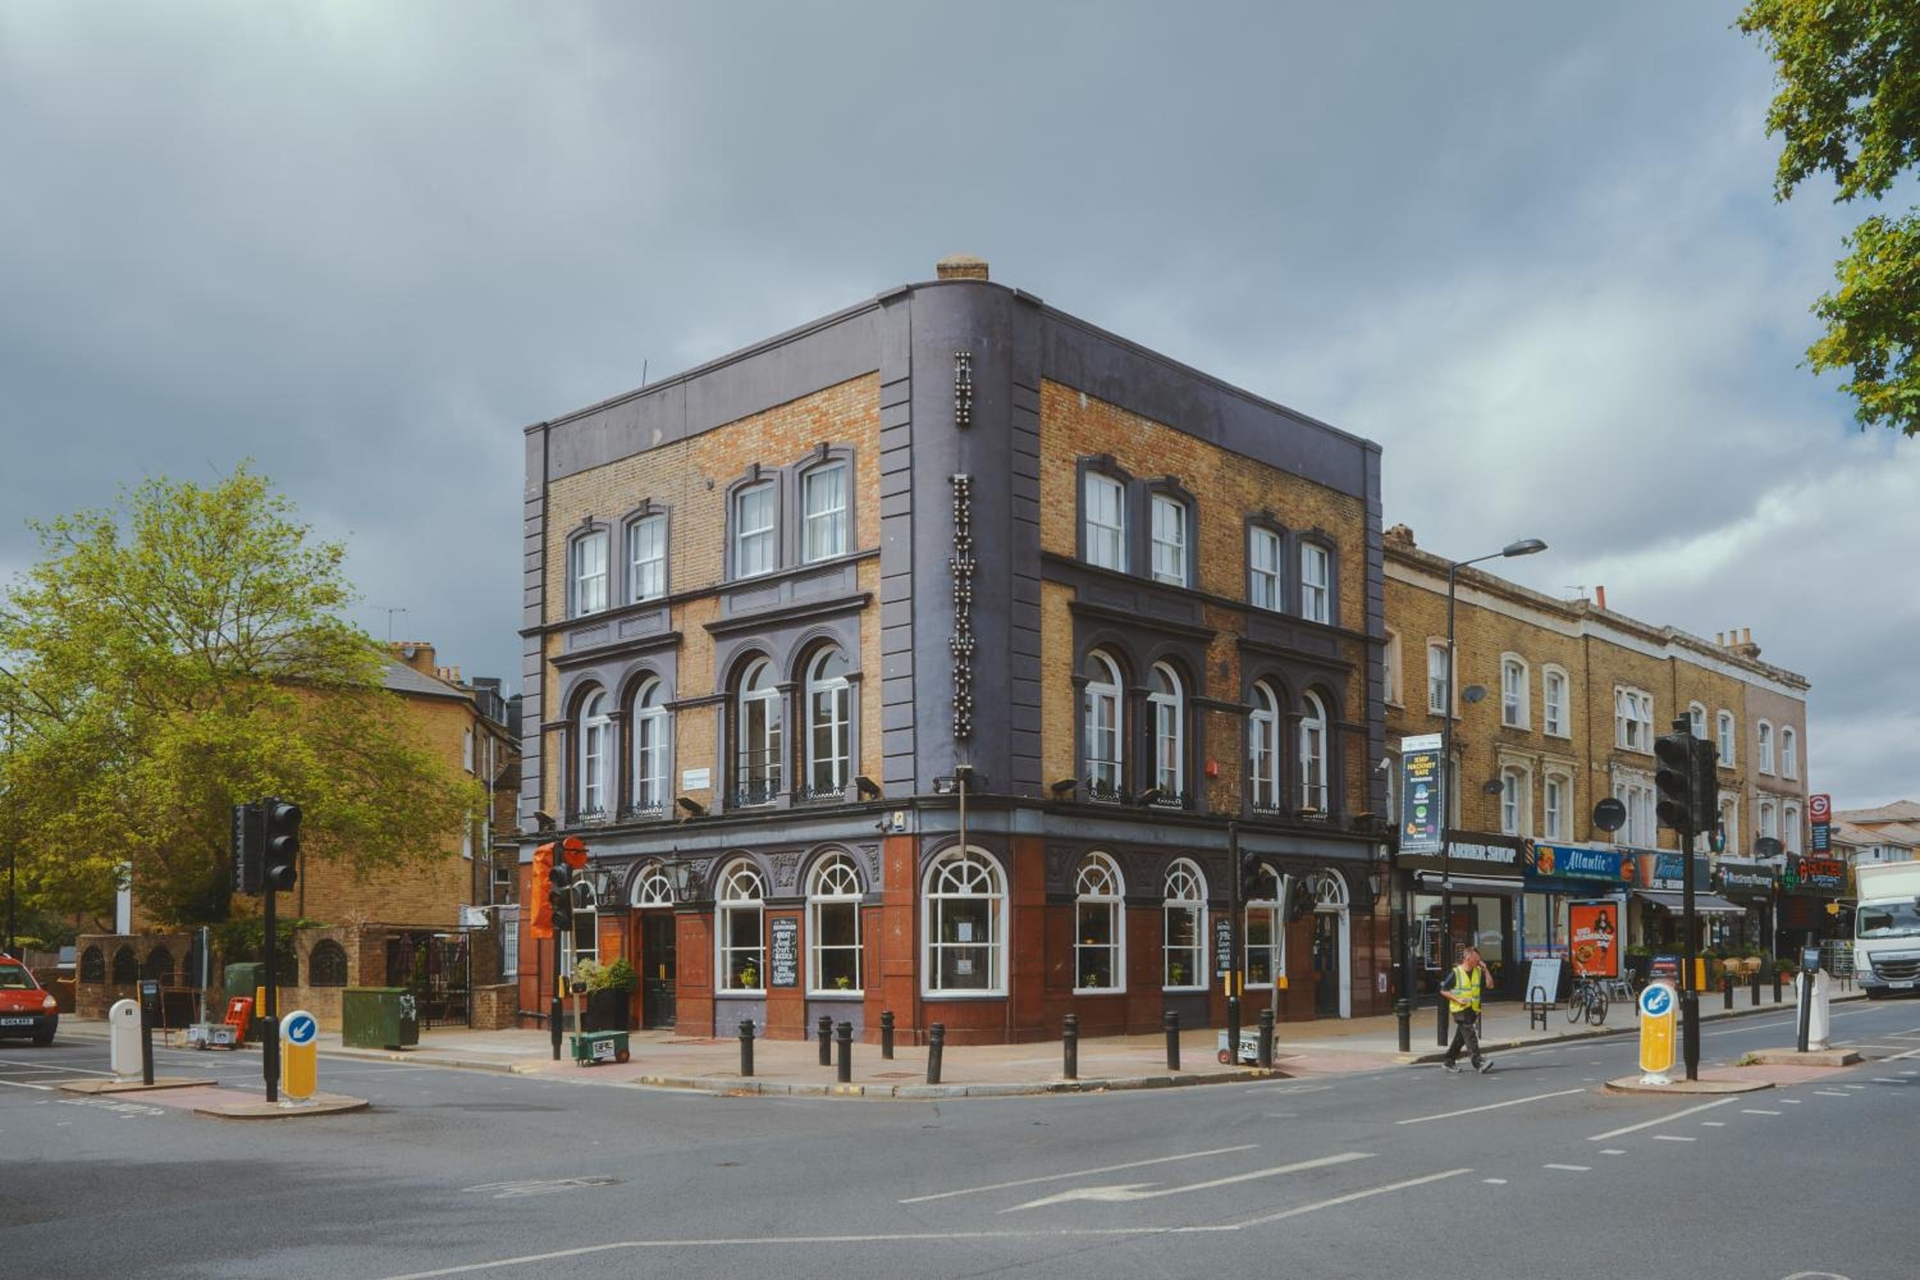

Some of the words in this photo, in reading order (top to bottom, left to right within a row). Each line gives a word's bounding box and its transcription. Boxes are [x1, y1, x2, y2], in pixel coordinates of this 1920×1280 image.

[1448, 842, 1486, 861] ARBER
[1487, 845, 1517, 863] SHOP
[1563, 851, 1606, 872] Atlantic
